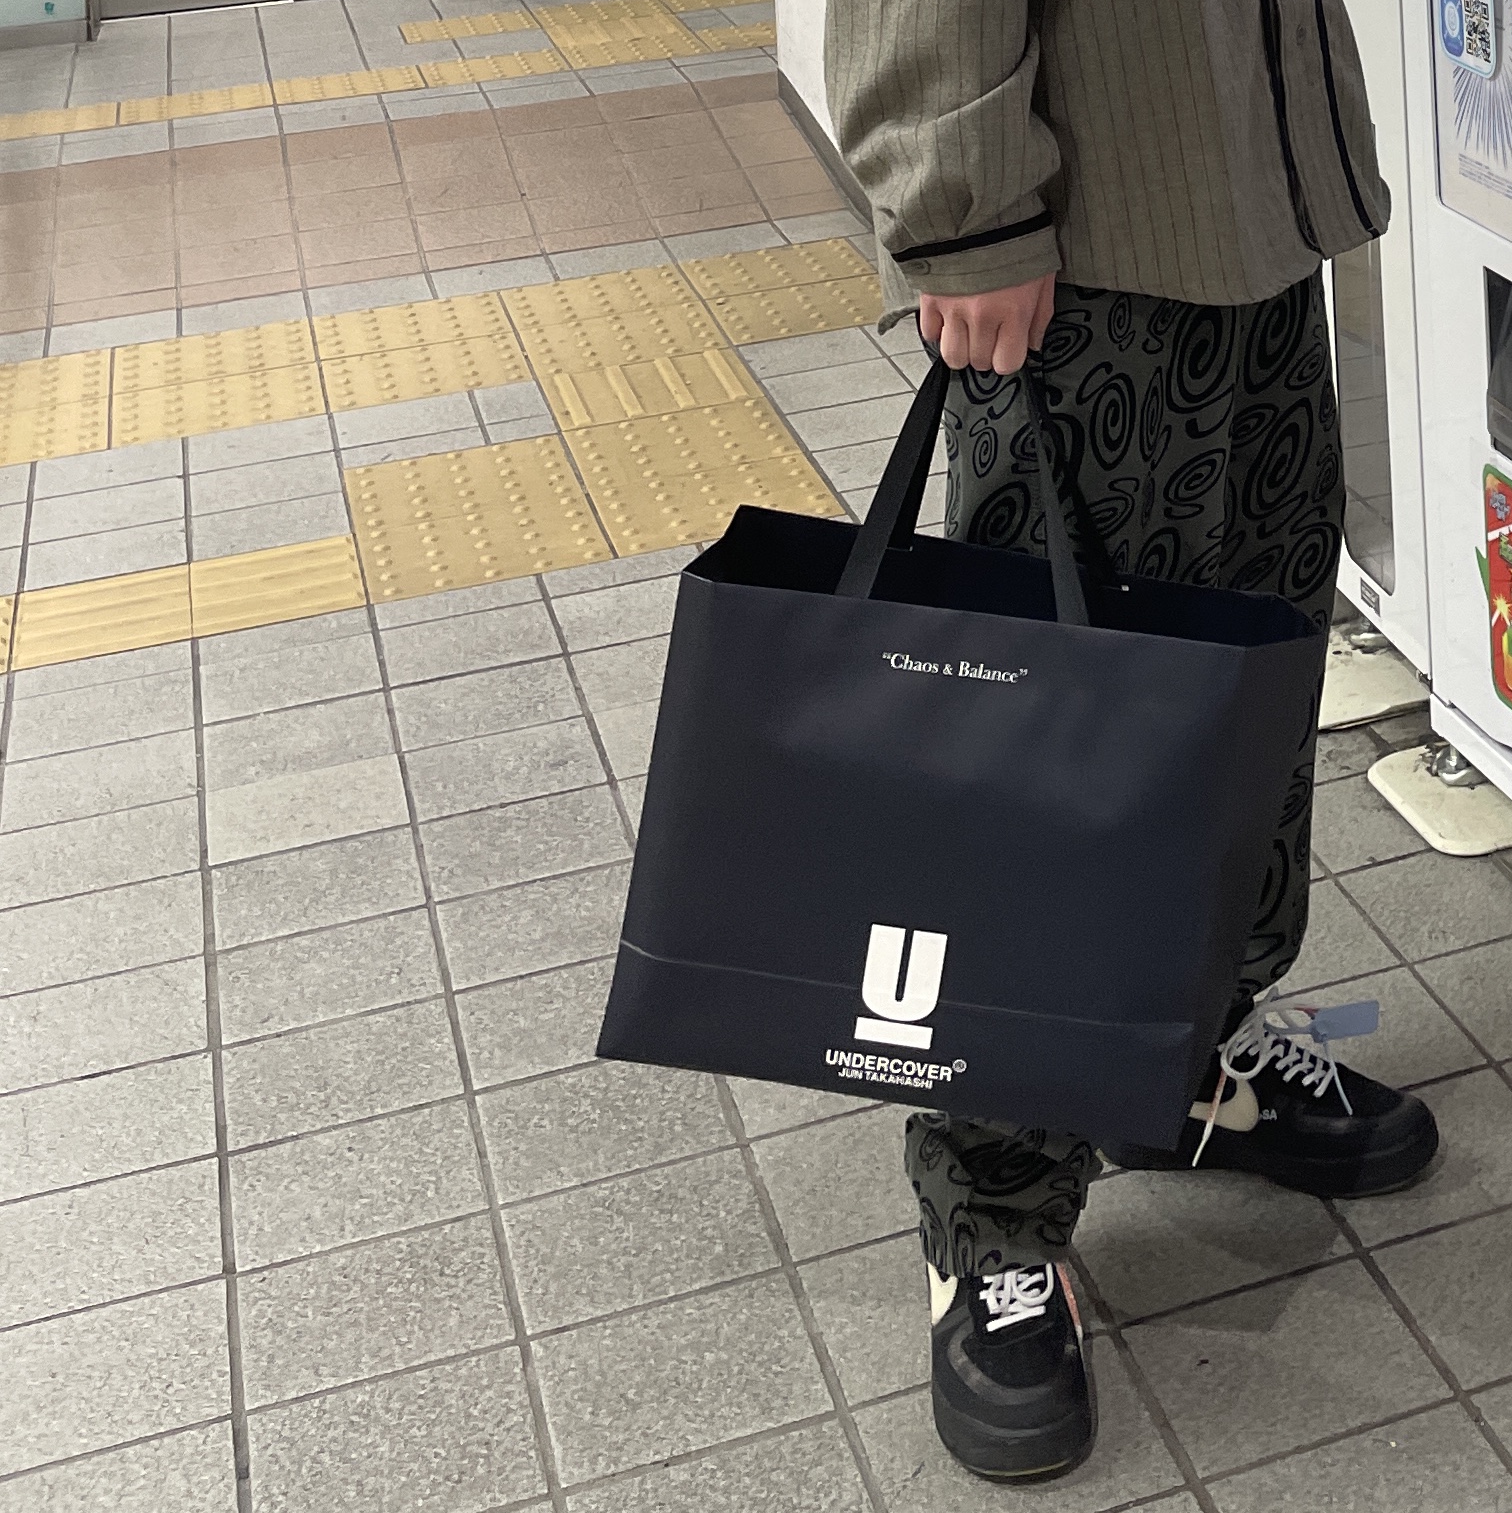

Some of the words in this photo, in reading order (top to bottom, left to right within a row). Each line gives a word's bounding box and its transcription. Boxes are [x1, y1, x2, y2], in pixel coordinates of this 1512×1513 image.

[943, 663, 953, 677] &
[825, 1049, 953, 1083] UNDERCOVER
[866, 1071, 933, 1090] TAKAHASHI
